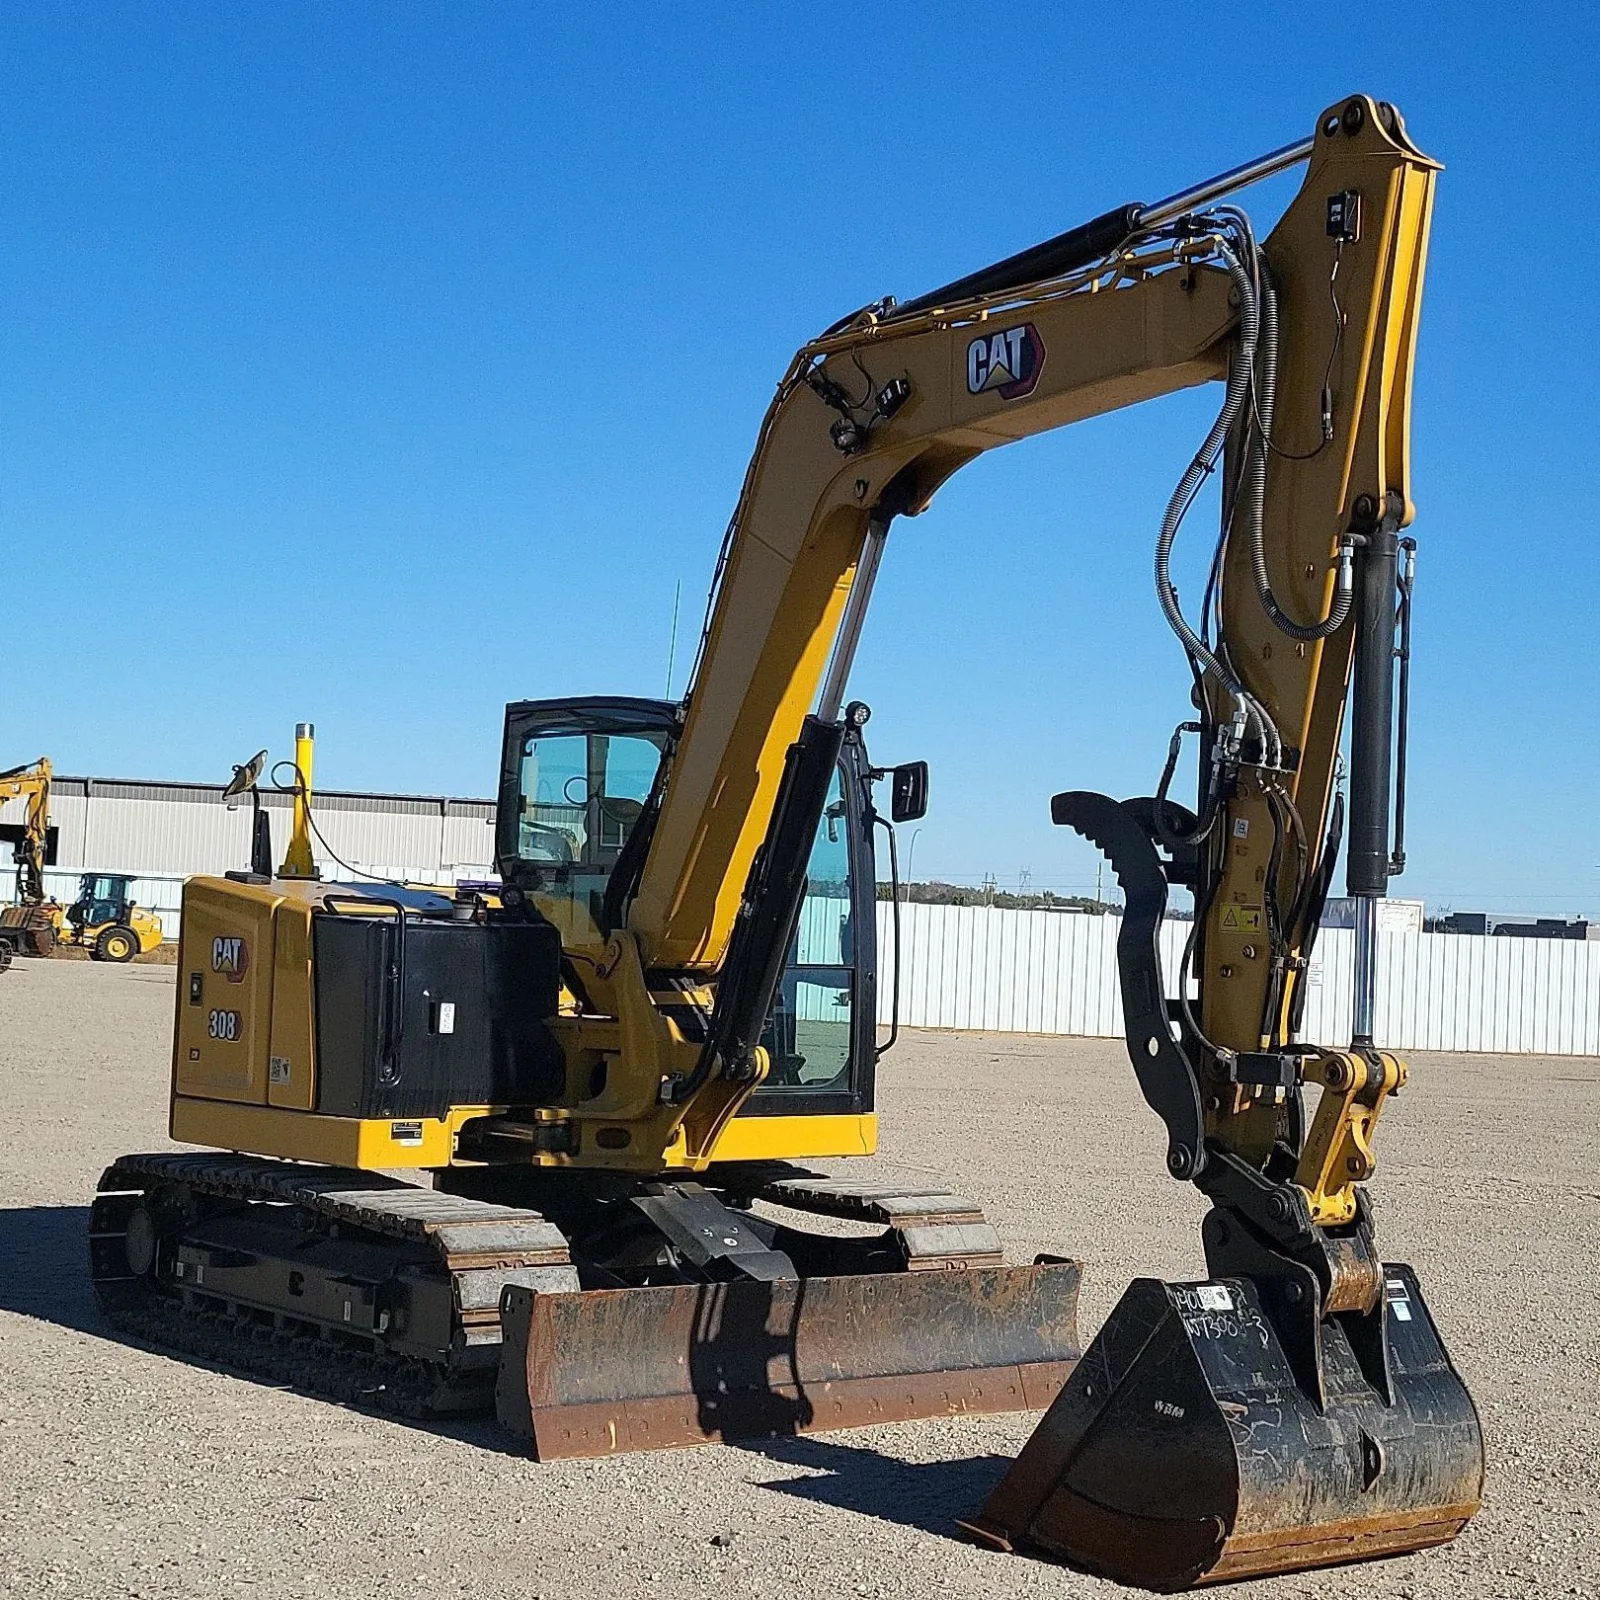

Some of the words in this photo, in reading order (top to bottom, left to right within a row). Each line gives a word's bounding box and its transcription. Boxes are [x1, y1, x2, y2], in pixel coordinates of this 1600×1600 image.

[968, 327, 1026, 393] CAT
[213, 937, 241, 972] CAT
[209, 1010, 236, 1040] 308
